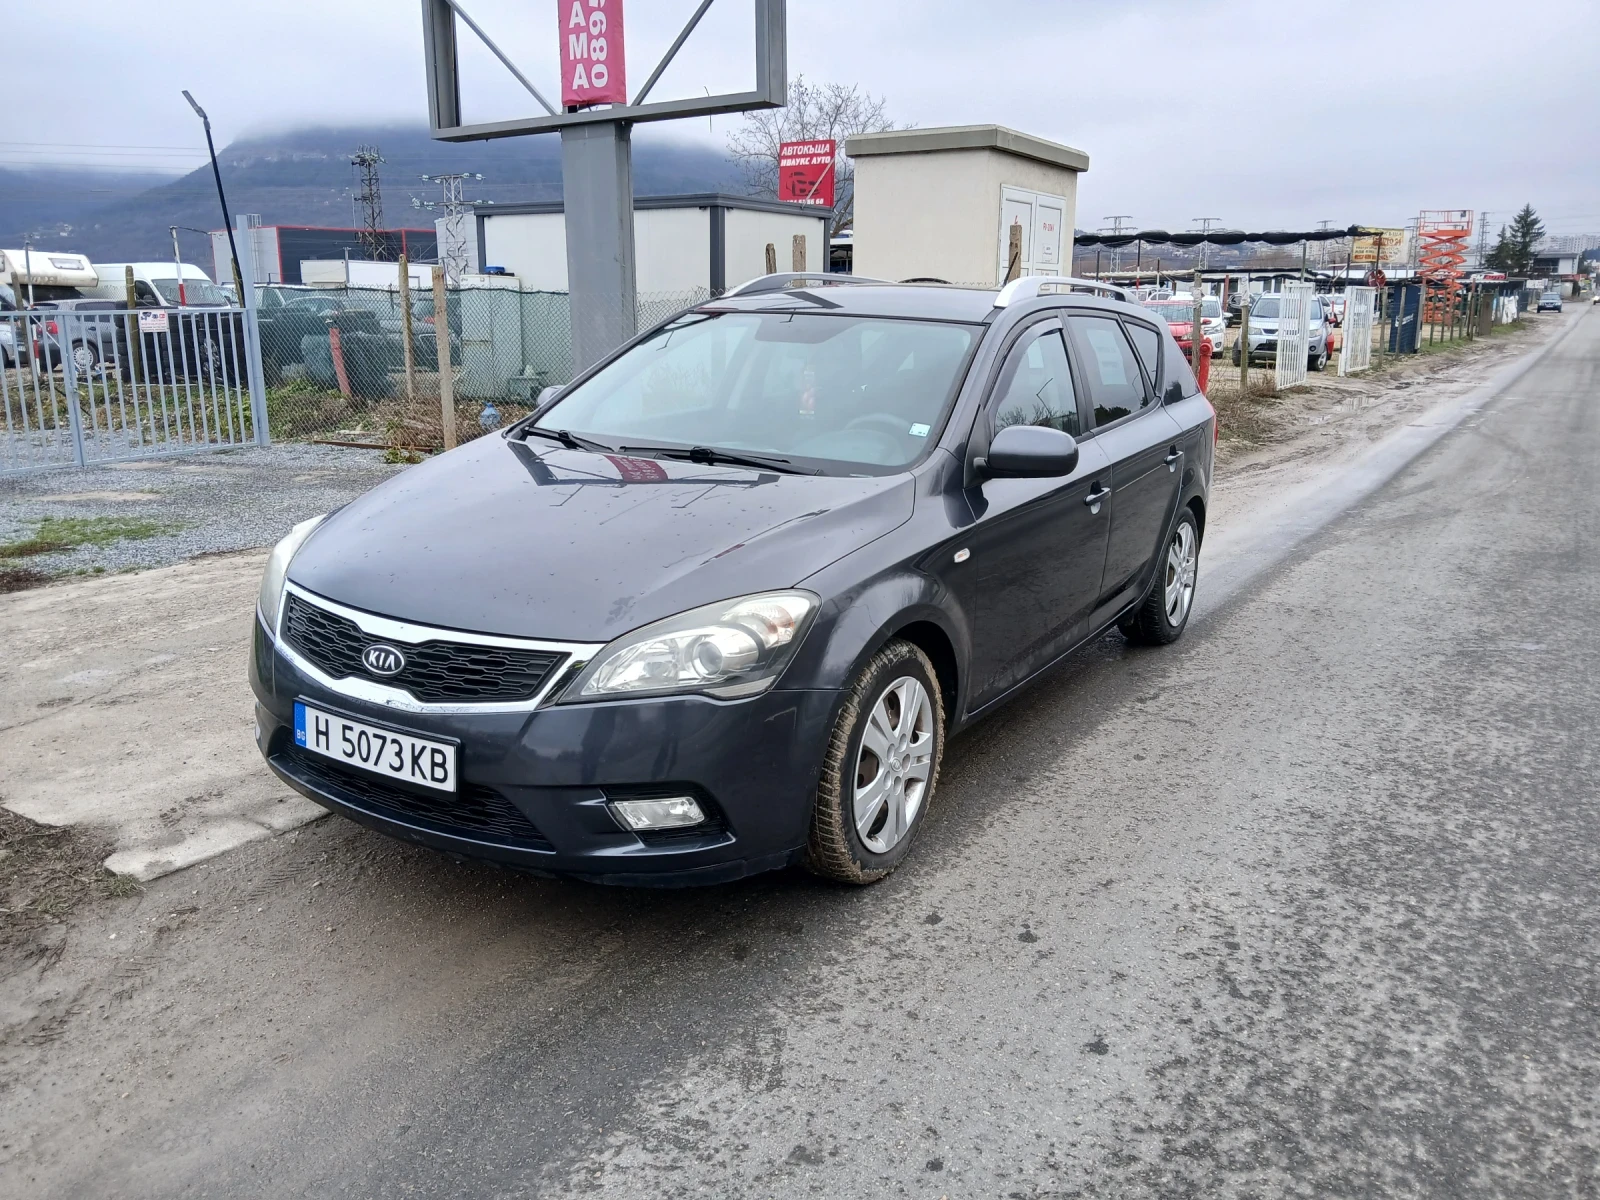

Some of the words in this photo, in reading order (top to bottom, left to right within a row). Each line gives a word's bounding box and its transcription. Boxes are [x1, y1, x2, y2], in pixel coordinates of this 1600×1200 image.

[781, 143, 830, 156] АВТОКЪЩА
[368, 650, 396, 671] KIA
[296, 729, 306, 741] BG
